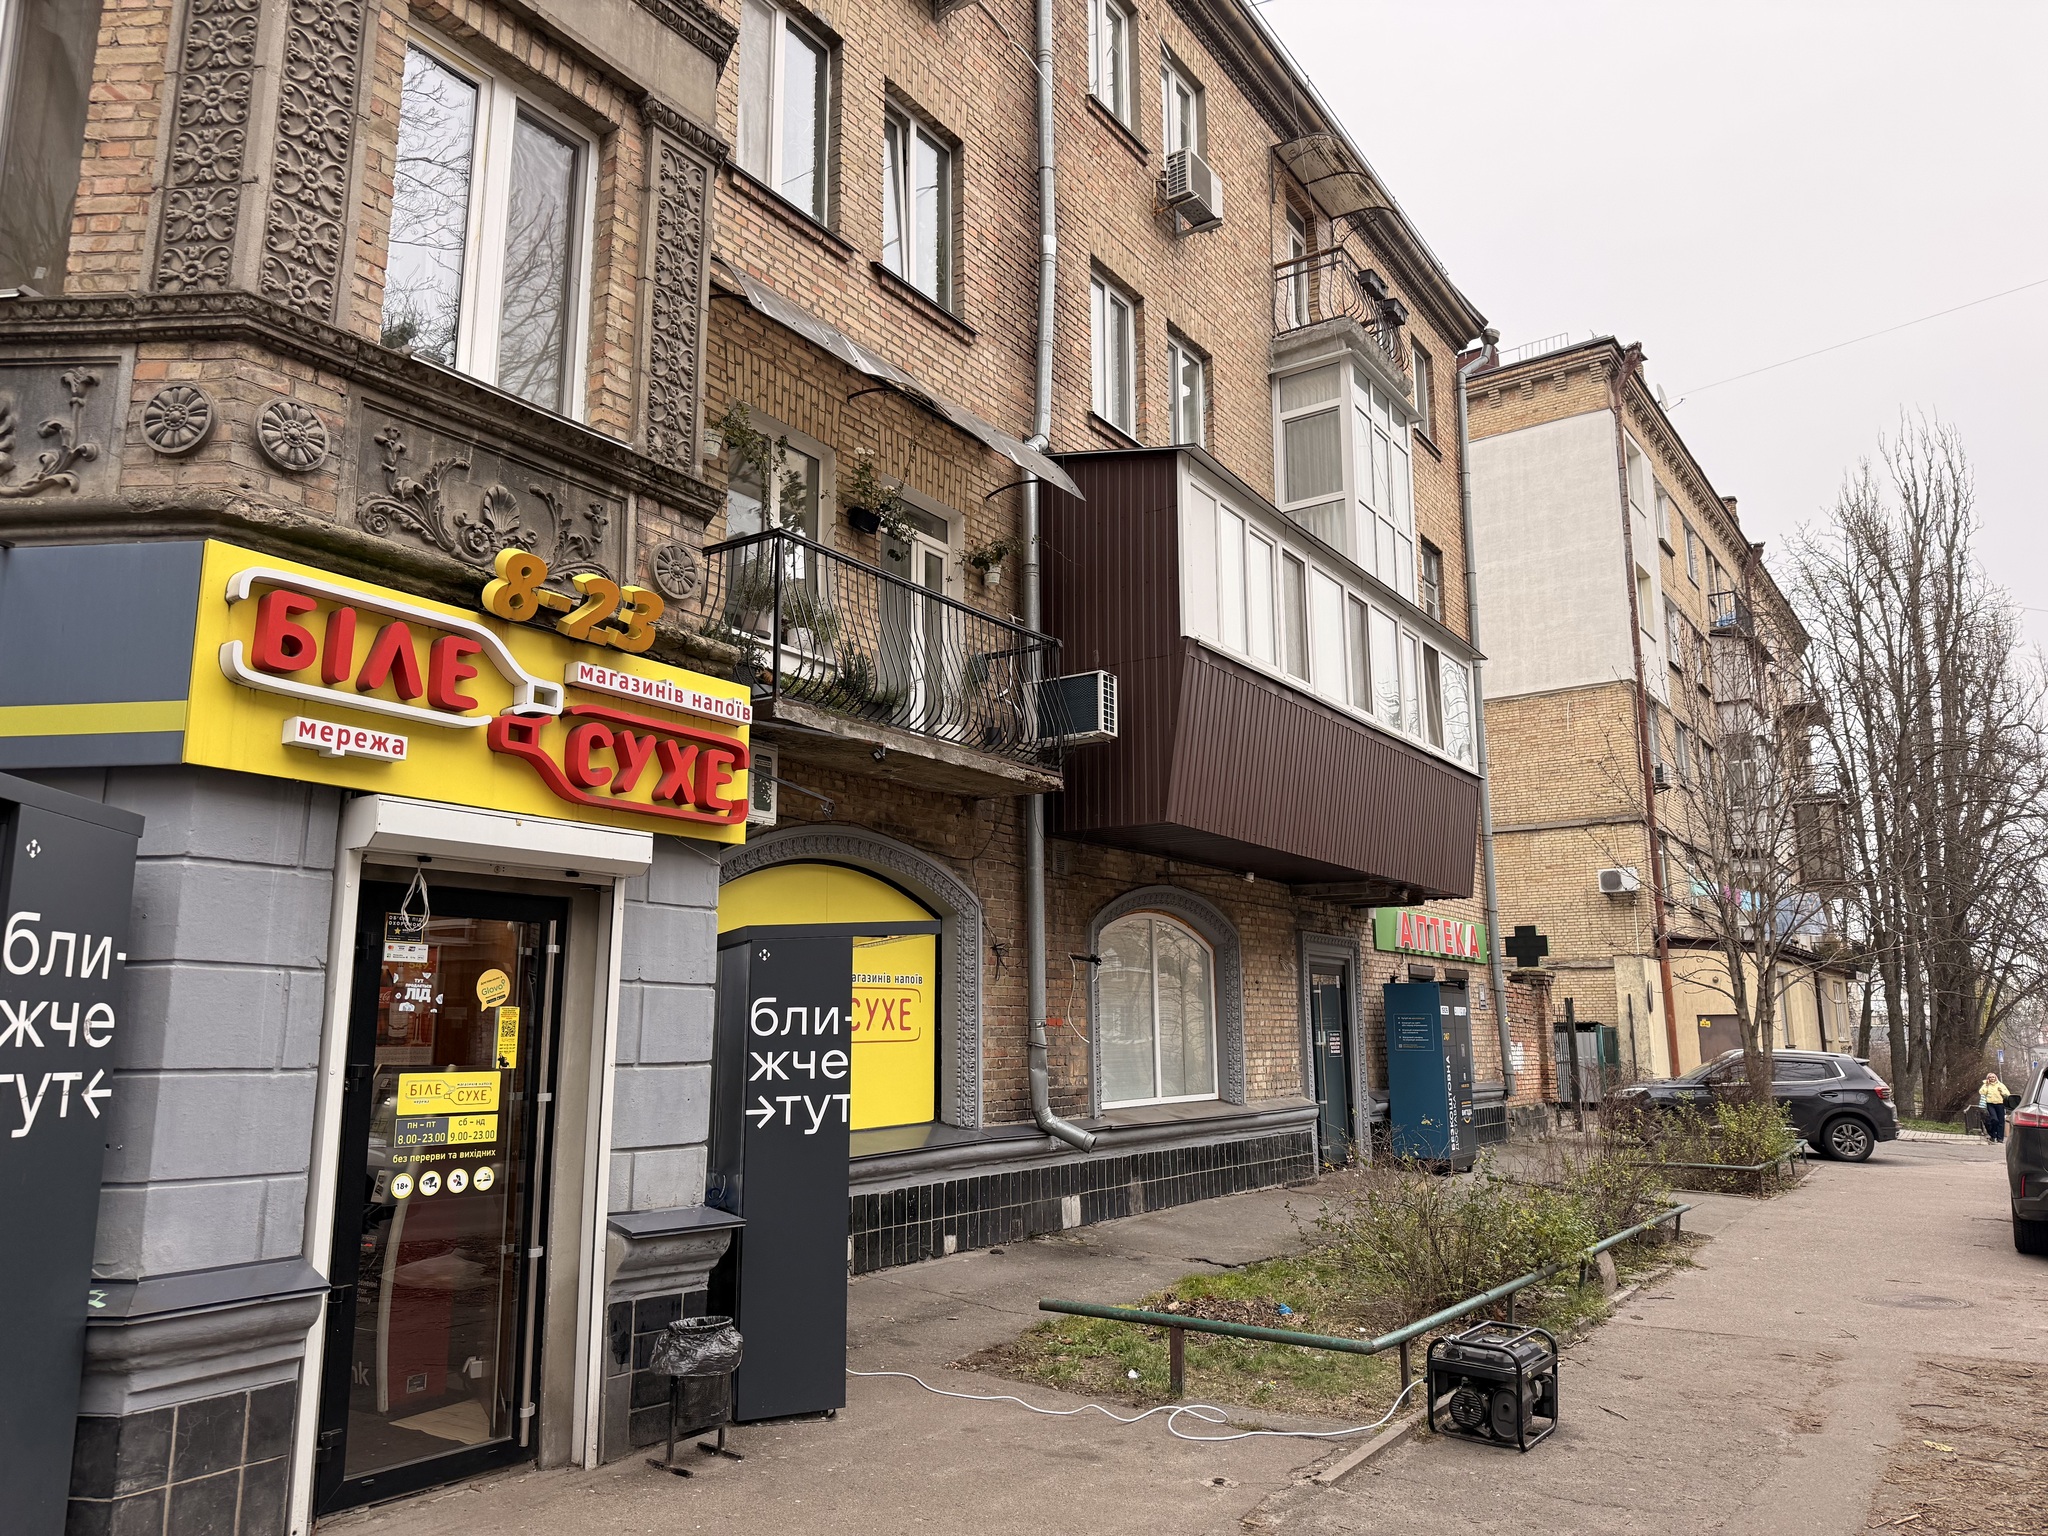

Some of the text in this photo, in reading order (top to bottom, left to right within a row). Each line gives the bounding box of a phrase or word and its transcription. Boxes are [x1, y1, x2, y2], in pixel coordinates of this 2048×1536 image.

[481, 547, 665, 654] 8-23
[251, 589, 483, 713] БІЛЕ
[580, 665, 751, 721] магазинів напоїв
[299, 720, 405, 756] мережа
[564, 721, 736, 813] СУХЕ
[3, 911, 127, 980] бли-
[1396, 911, 1481, 959] АПТЕКА
[404, 987, 431, 1003] ЛІД
[481, 983, 504, 996] Glovo
[851, 973, 923, 985] агазинів напоїв
[0, 1000, 116, 1048] жче
[750, 997, 853, 1037] бли-
[749, 1049, 849, 1081] жче
[410, 1083, 442, 1096] БІЛЕ
[457, 1089, 487, 1102] СУХЕ
[1446, 1055, 1456, 1150] БЕЗКОШТОВНА
[458, 1118, 468, 1126] сб
[475, 1118, 486, 1126] нд
[776, 1094, 851, 1135] тут
[1452, 1095, 1460, 1150] ДОСТАВКА
[397, 1132, 446, 1145] 8.00-23.00
[450, 1129, 495, 1142] 9.00-23.00
[392, 1154, 408, 1163] без
[409, 1152, 446, 1164] перерви
[459, 1148, 497, 1159] вихідних
[396, 1182, 409, 1190] 18+
